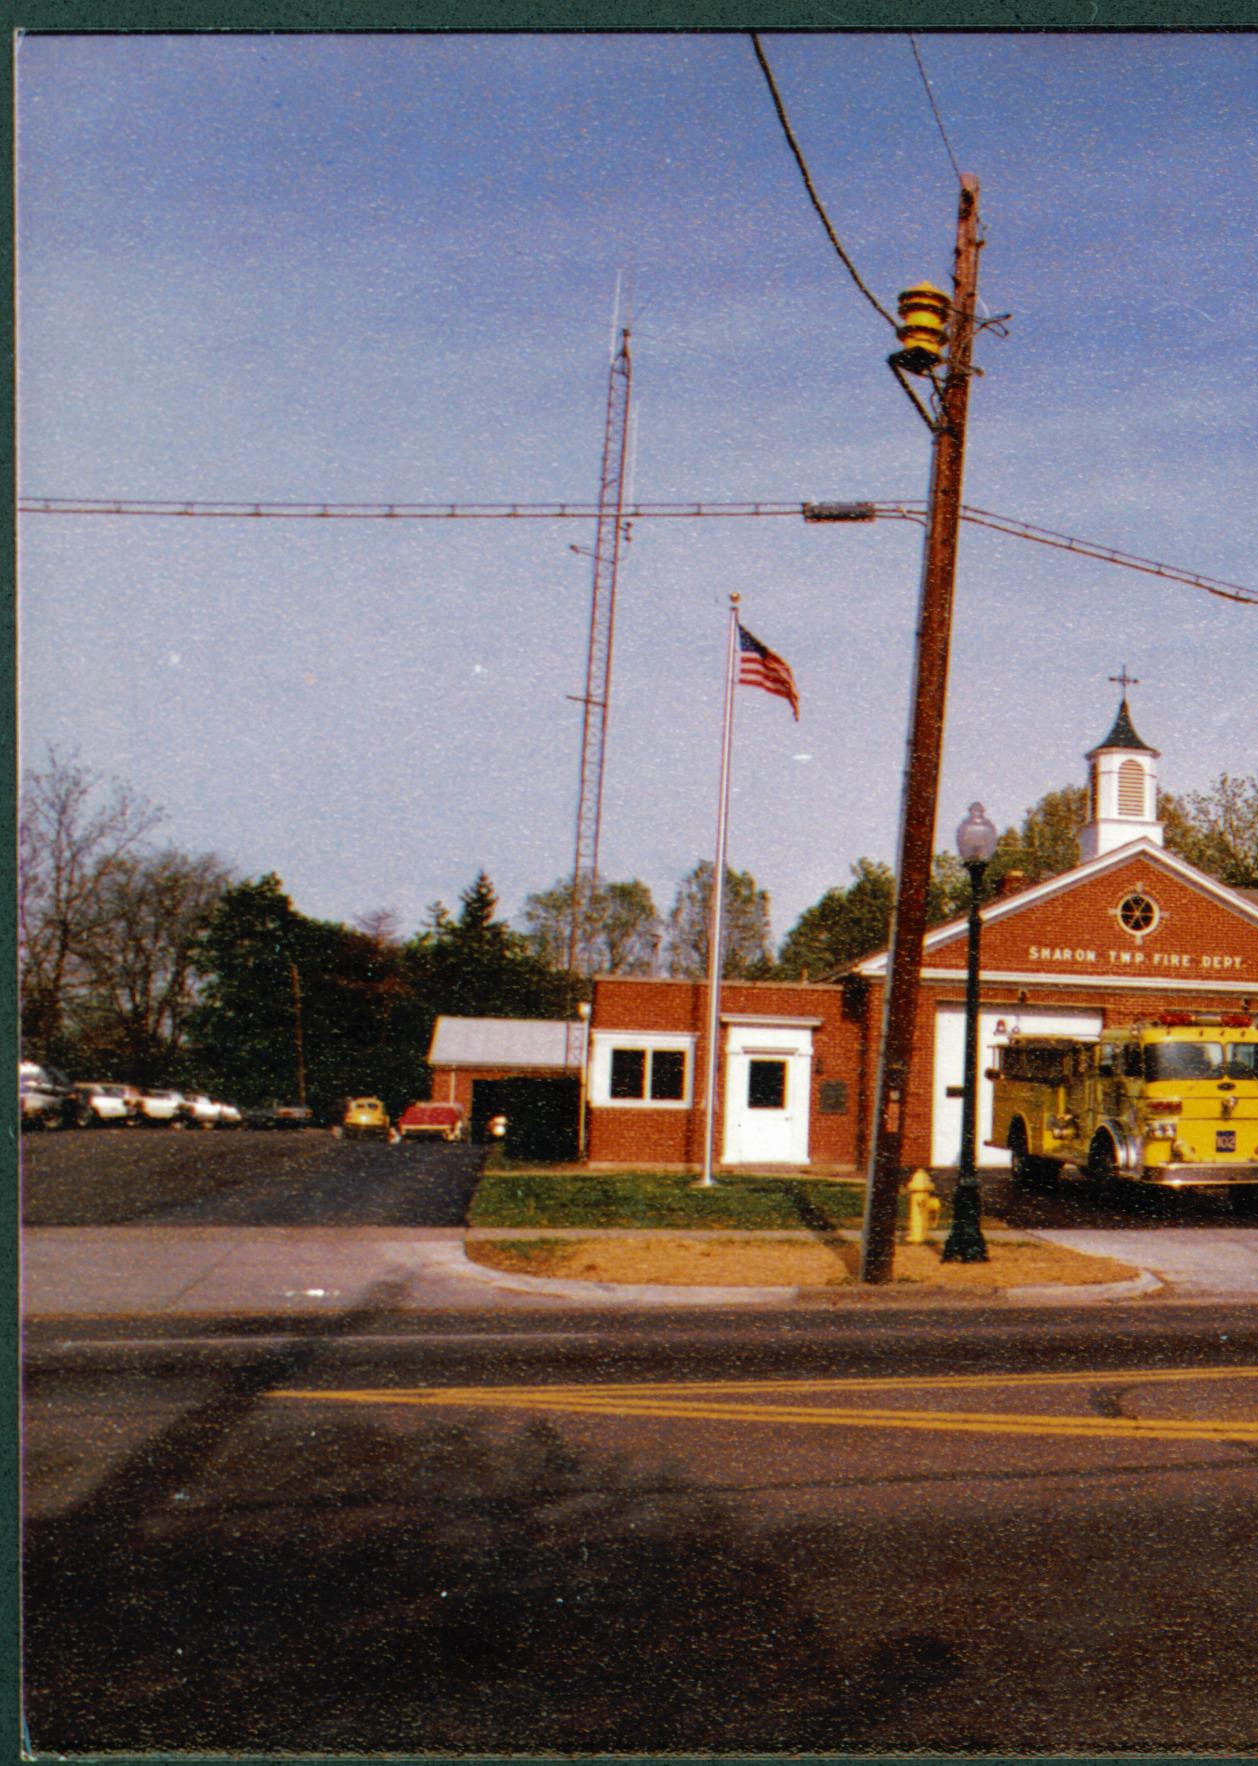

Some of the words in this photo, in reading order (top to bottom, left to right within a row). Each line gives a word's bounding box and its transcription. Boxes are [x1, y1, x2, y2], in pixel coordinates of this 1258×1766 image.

[1028, 945, 1097, 963] SHARON
[1109, 949, 1144, 965] TWP
[1153, 952, 1191, 967] FIRE
